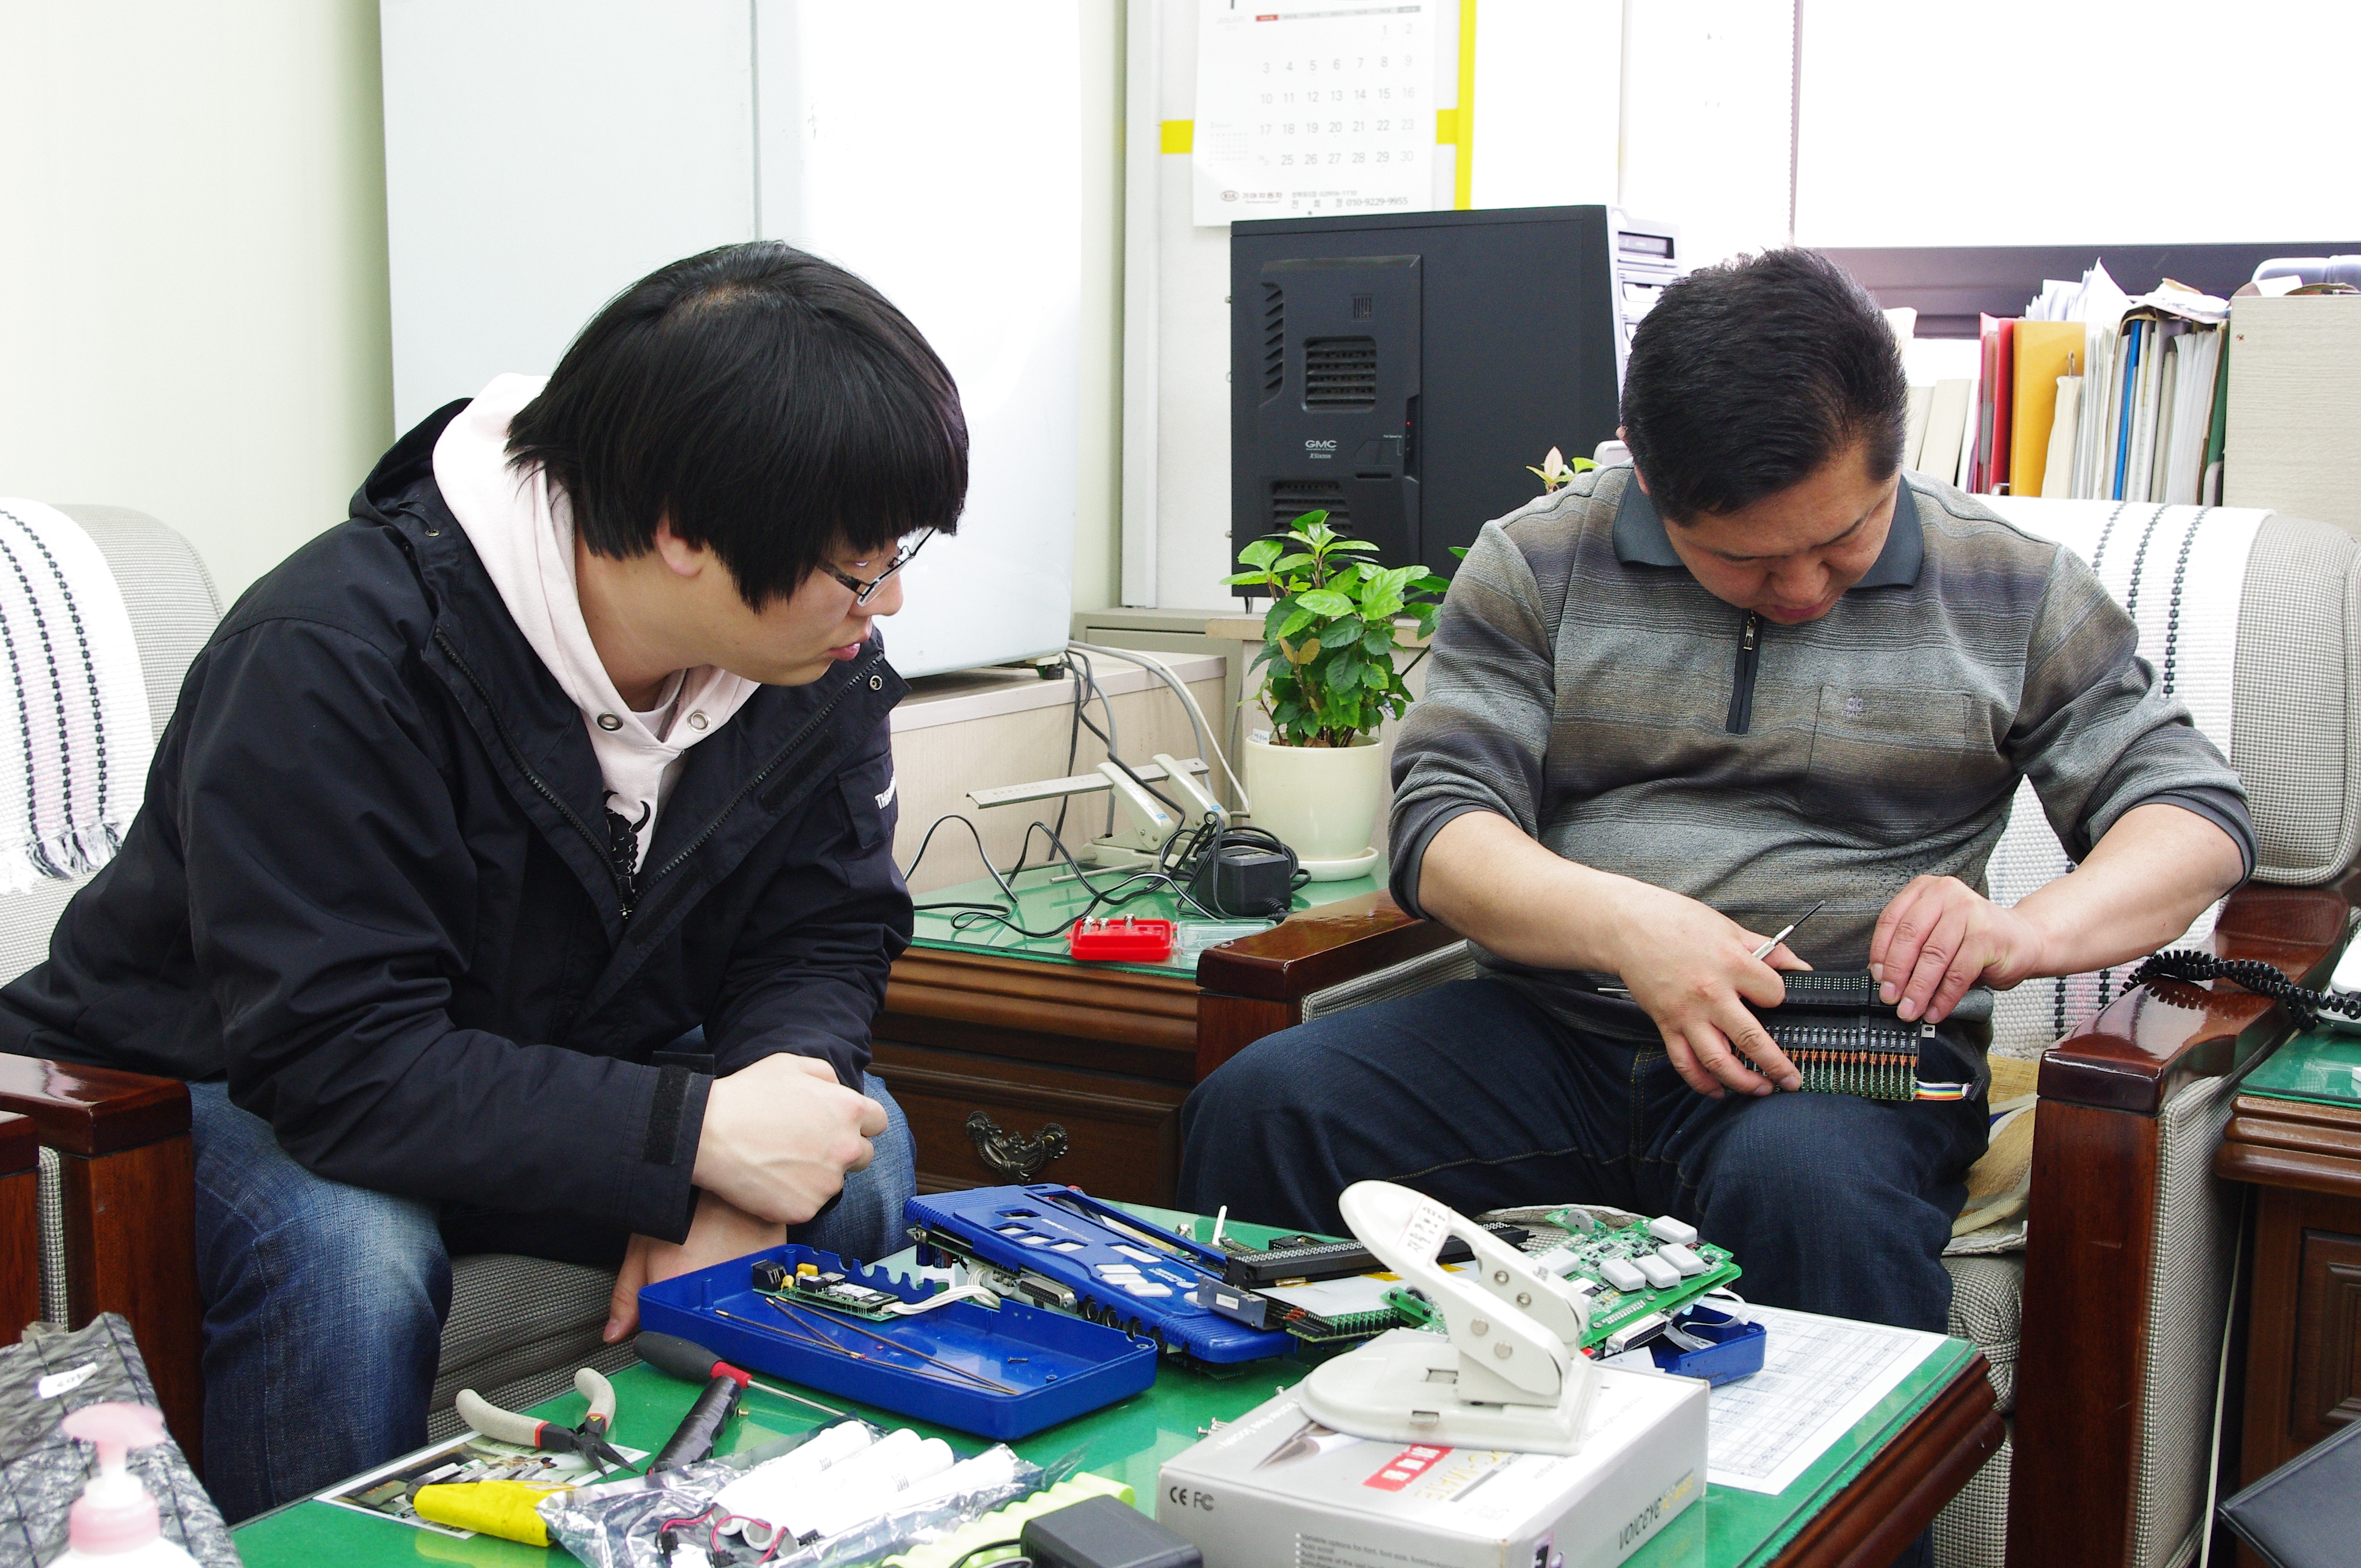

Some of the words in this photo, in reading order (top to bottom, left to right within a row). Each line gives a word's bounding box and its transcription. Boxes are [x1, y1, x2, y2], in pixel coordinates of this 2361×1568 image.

[1383, 25, 1388, 35] 1
[1406, 23, 1413, 34] 2
[1263, 62, 1270, 73] 3
[1286, 62, 1293, 71] 4
[1310, 60, 1316, 71] 5
[1333, 58, 1341, 69] 6
[1357, 58, 1364, 68] 7
[1381, 56, 1388, 68] 8
[1405, 55, 1412, 66] 9
[1261, 93, 1272, 104] 10
[1283, 93, 1294, 102] 11
[1307, 91, 1319, 102] 12
[1331, 90, 1343, 101] 13
[1354, 89, 1367, 100] 14
[1378, 88, 1390, 99] 15
[1403, 87, 1415, 98] 16
[1260, 125, 1271, 135] 17
[1283, 124, 1294, 133] 18
[1307, 123, 1318, 133] 19
[1329, 122, 1342, 133] 20
[1352, 121, 1364, 132] 21
[1377, 120, 1390, 130] 22
[1401, 119, 1414, 130] 23
[1281, 155, 1293, 165] 25
[1304, 154, 1318, 165] 26
[1328, 153, 1341, 164] 27
[1352, 153, 1365, 163] 28
[1376, 151, 1389, 162] 29
[1400, 151, 1413, 161] 30
[1346, 197, 1407, 206] 010-9229-9955
[1305, 440, 1337, 448] GMC
[1169, 1486, 1187, 1505] CE
